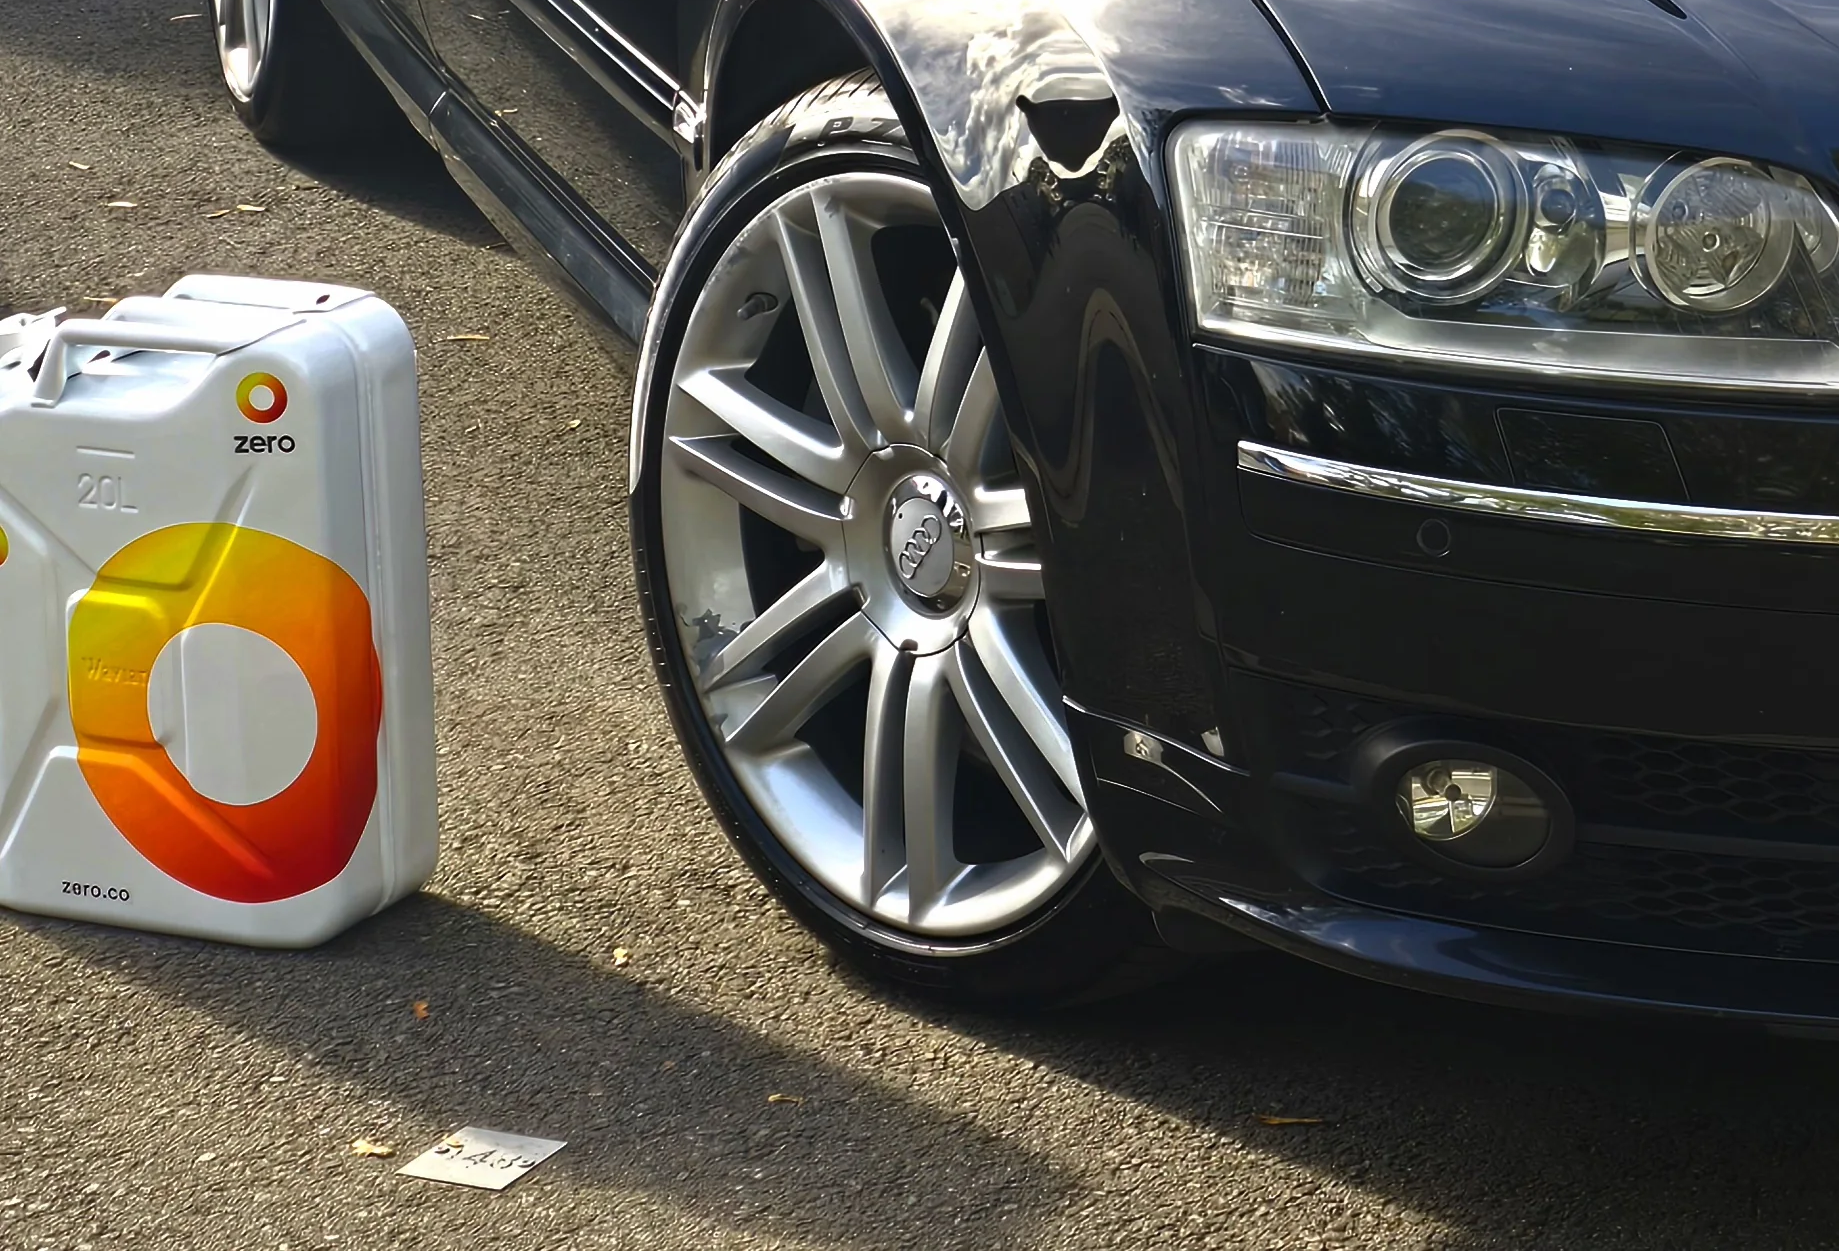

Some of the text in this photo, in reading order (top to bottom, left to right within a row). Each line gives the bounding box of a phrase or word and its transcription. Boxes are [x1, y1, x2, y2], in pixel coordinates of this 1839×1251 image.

[233, 435, 296, 454] zero
[77, 472, 139, 514] 20L
[61, 881, 130, 902] zero.co
